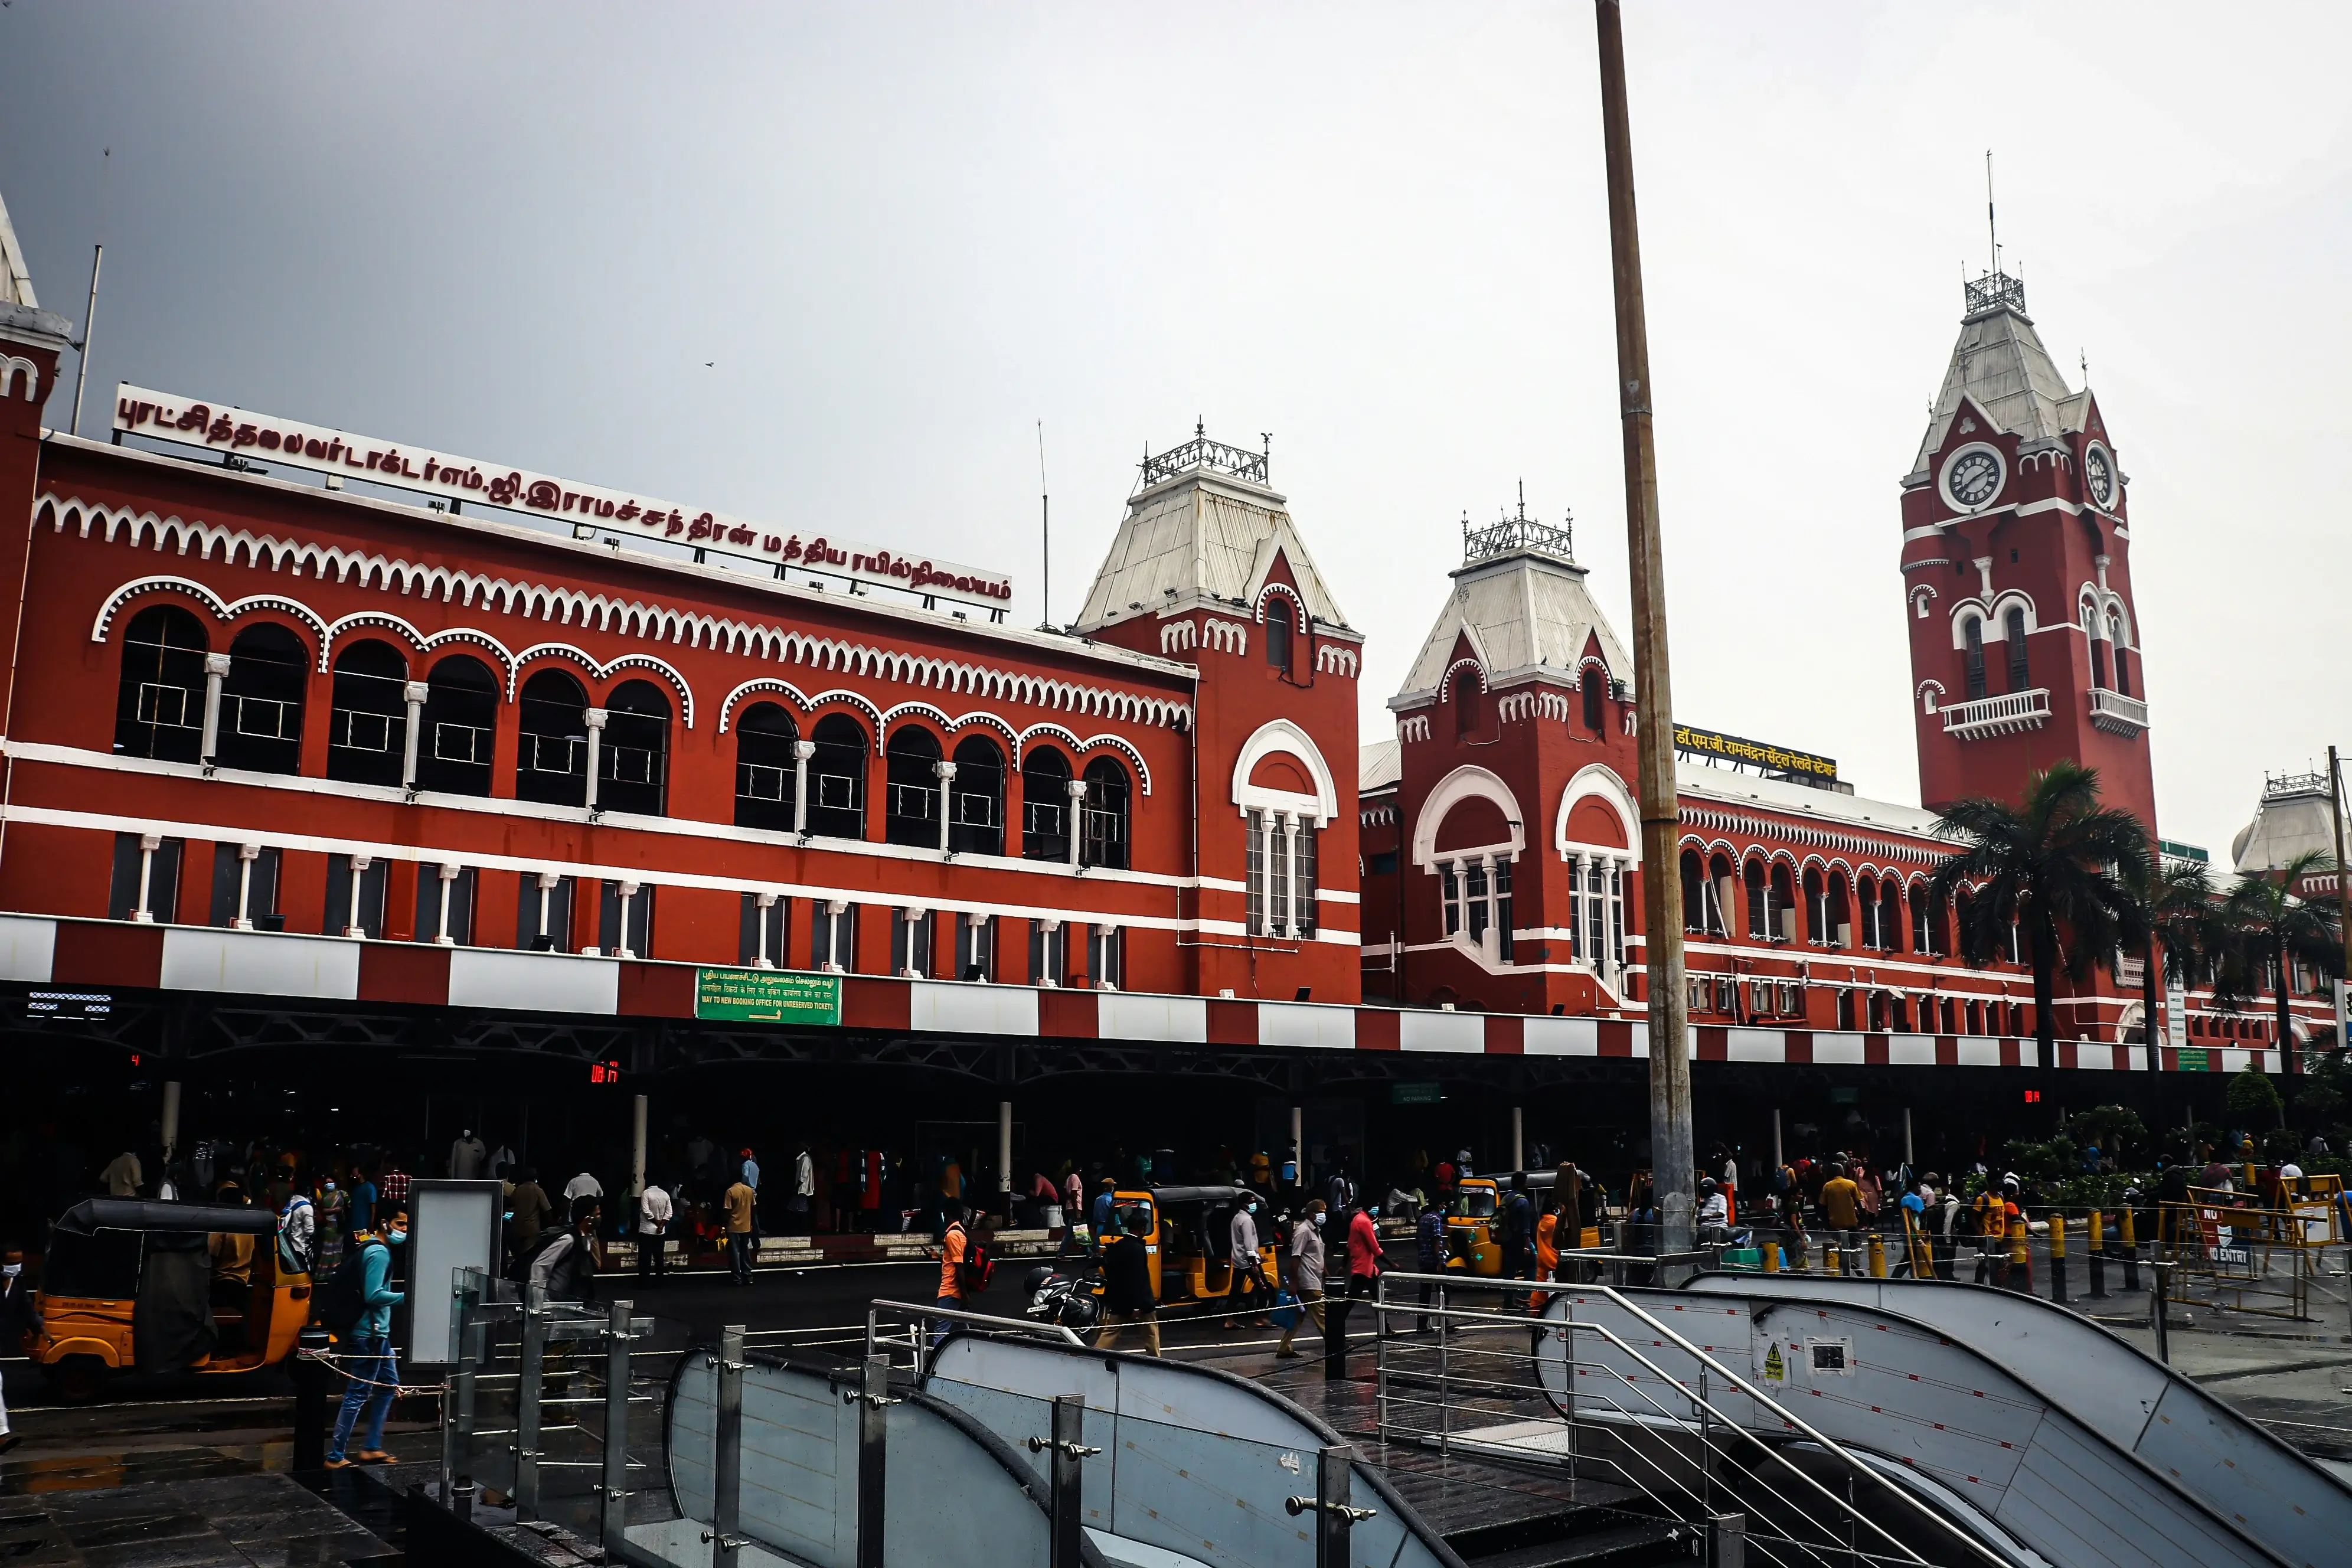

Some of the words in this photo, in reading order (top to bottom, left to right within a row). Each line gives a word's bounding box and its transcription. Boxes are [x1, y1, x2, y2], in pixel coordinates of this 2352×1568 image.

[763, 534, 847, 565] மத்திய
[1766, 746, 1790, 769] सेंट्रल
[1788, 751, 1812, 772] रेलवे
[1812, 757, 1837, 776] स्टेशन
[703, 970, 718, 981] புதிய
[760, 976, 794, 985] அலுவலகம்
[795, 976, 821, 988] செல்லும்
[822, 978, 834, 989] வழி
[740, 985, 746, 994] के
[746, 985, 756, 997] लिए
[758, 988, 765, 997] नए
[733, 997, 754, 1005] BOOKING
[755, 998, 772, 1007] OFFICE
[783, 1000, 814, 1009] UNRESERVED
[2204, 1209, 2217, 1220] NO
[2220, 1248, 2247, 1263] ENTRY
[1765, 1361, 1783, 1370] Danger
